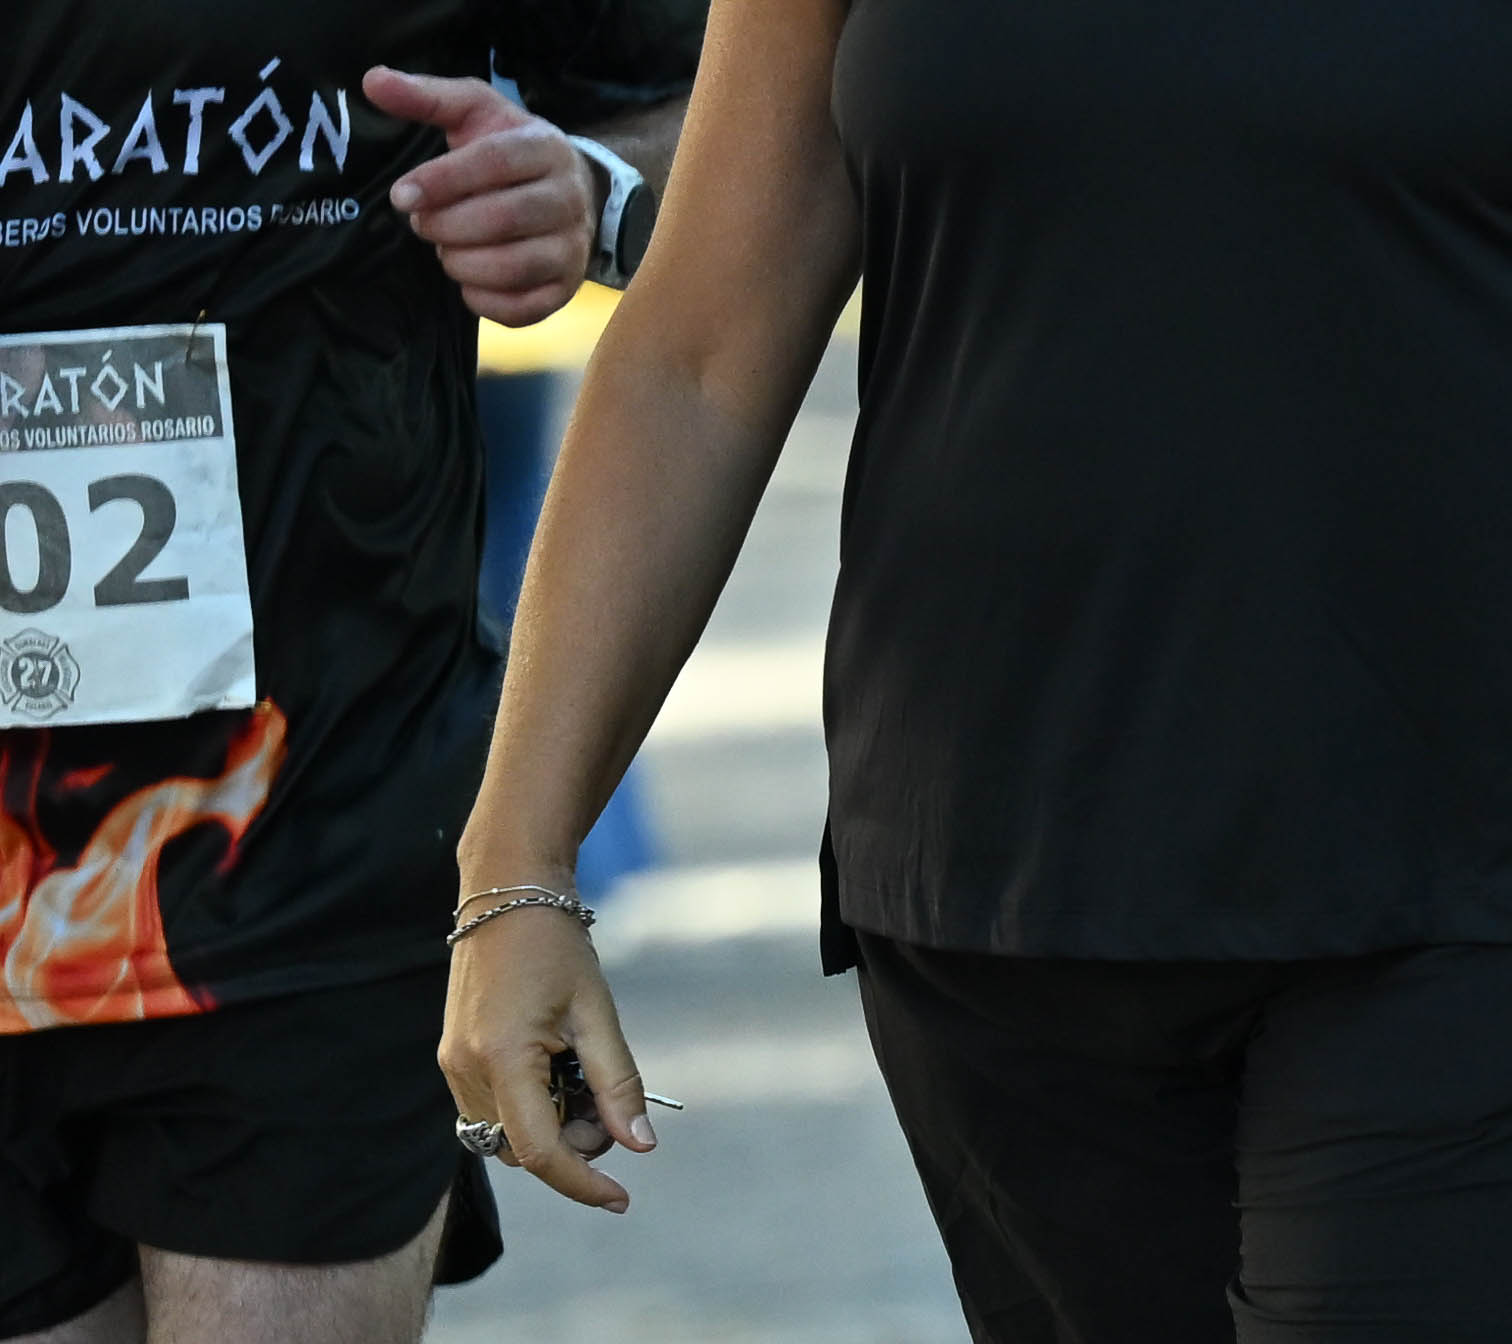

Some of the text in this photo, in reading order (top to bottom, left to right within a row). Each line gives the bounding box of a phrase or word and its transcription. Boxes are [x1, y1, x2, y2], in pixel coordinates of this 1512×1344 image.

[76, 205, 262, 236] VOLUNTARIOS
[25, 422, 136, 449] VOLUNTARIOS
[141, 415, 216, 440] ROSARIO
